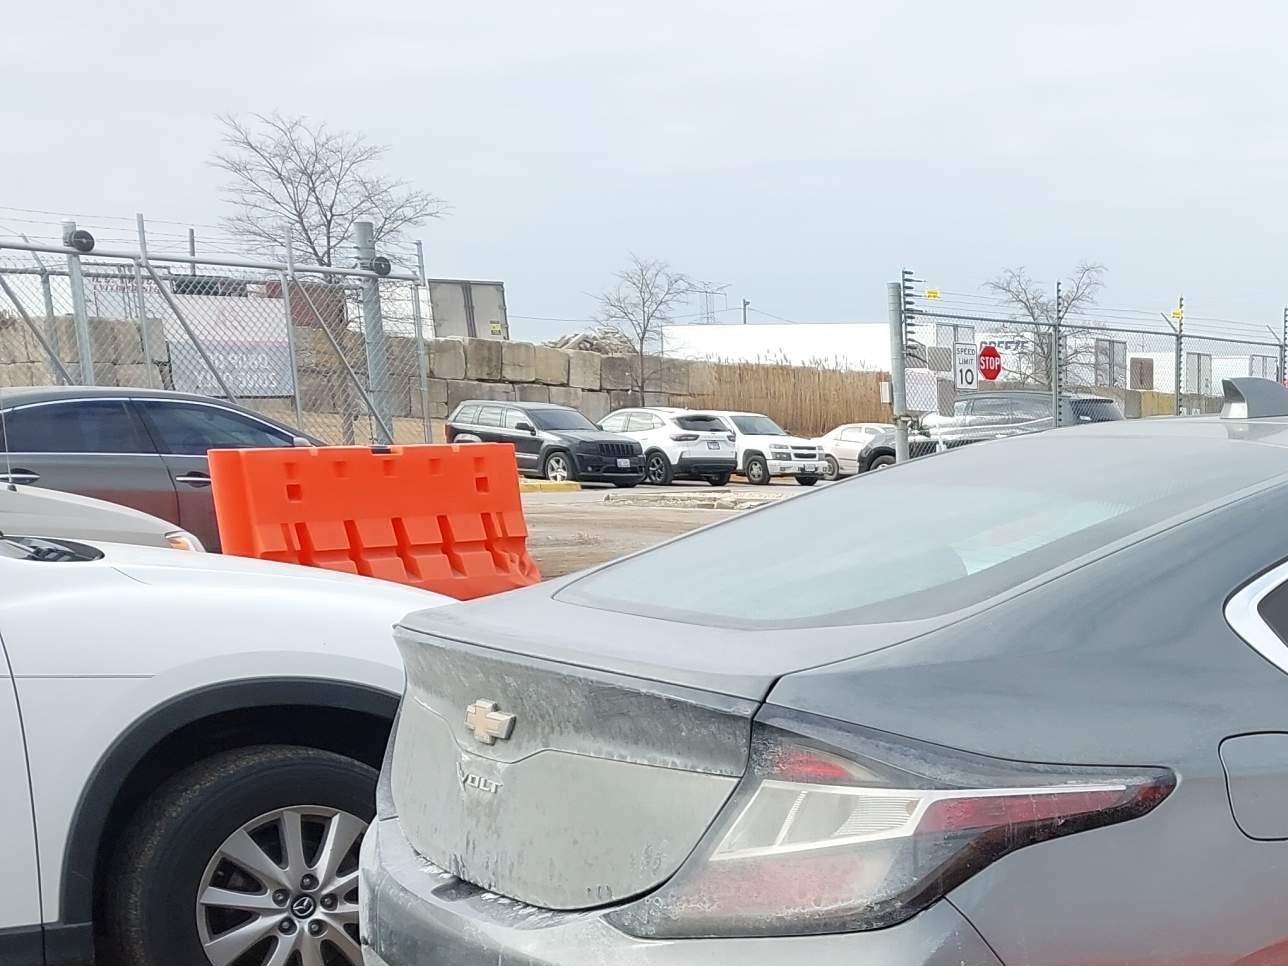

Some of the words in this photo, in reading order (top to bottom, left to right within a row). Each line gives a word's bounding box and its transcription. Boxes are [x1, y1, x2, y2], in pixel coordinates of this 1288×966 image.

[956, 347, 975, 356] SPEED
[980, 356, 1000, 370] STOP
[959, 368, 974, 385] 10
[456, 762, 504, 793] VOLT
